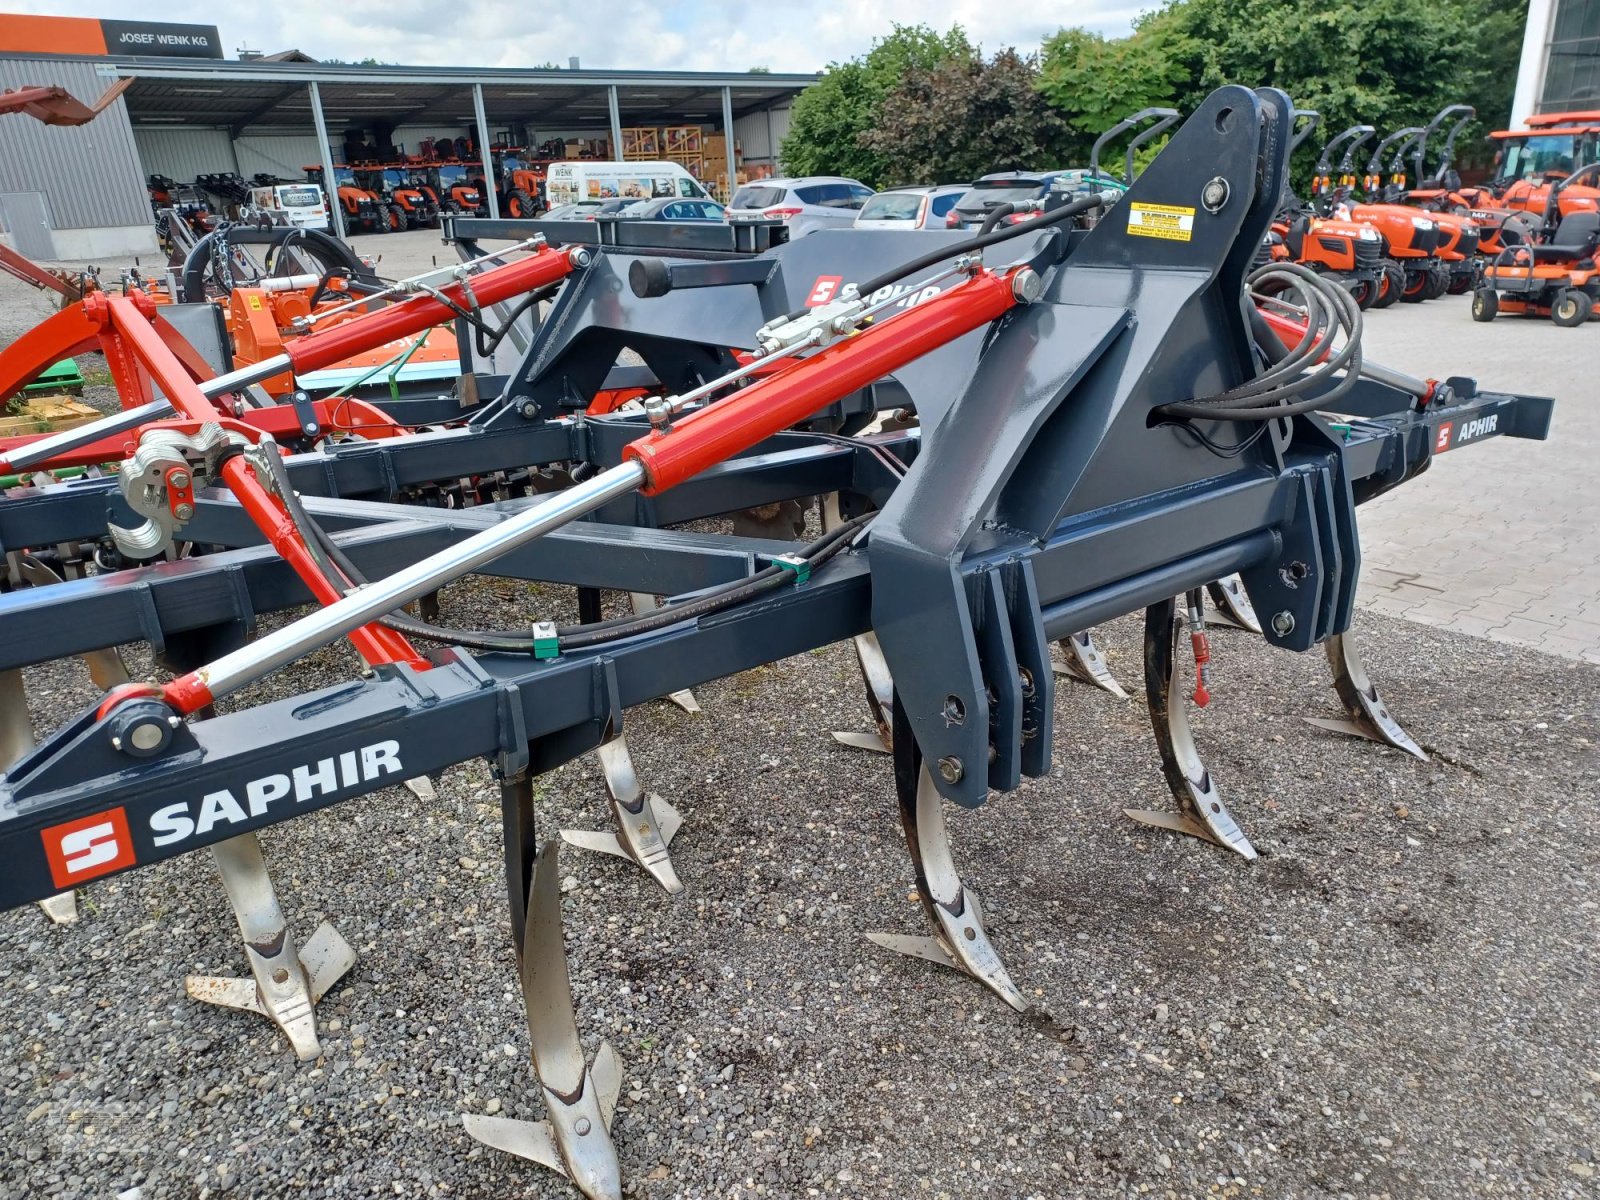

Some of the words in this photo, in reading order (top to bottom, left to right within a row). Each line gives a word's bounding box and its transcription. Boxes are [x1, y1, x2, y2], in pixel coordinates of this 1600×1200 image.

[119, 32, 155, 44] JOSEF
[156, 34, 190, 46] WENK
[191, 36, 208, 47] KG
[555, 167, 573, 177] WENK
[1457, 414, 1499, 442] APHIR
[149, 739, 403, 847] SAPHIR
